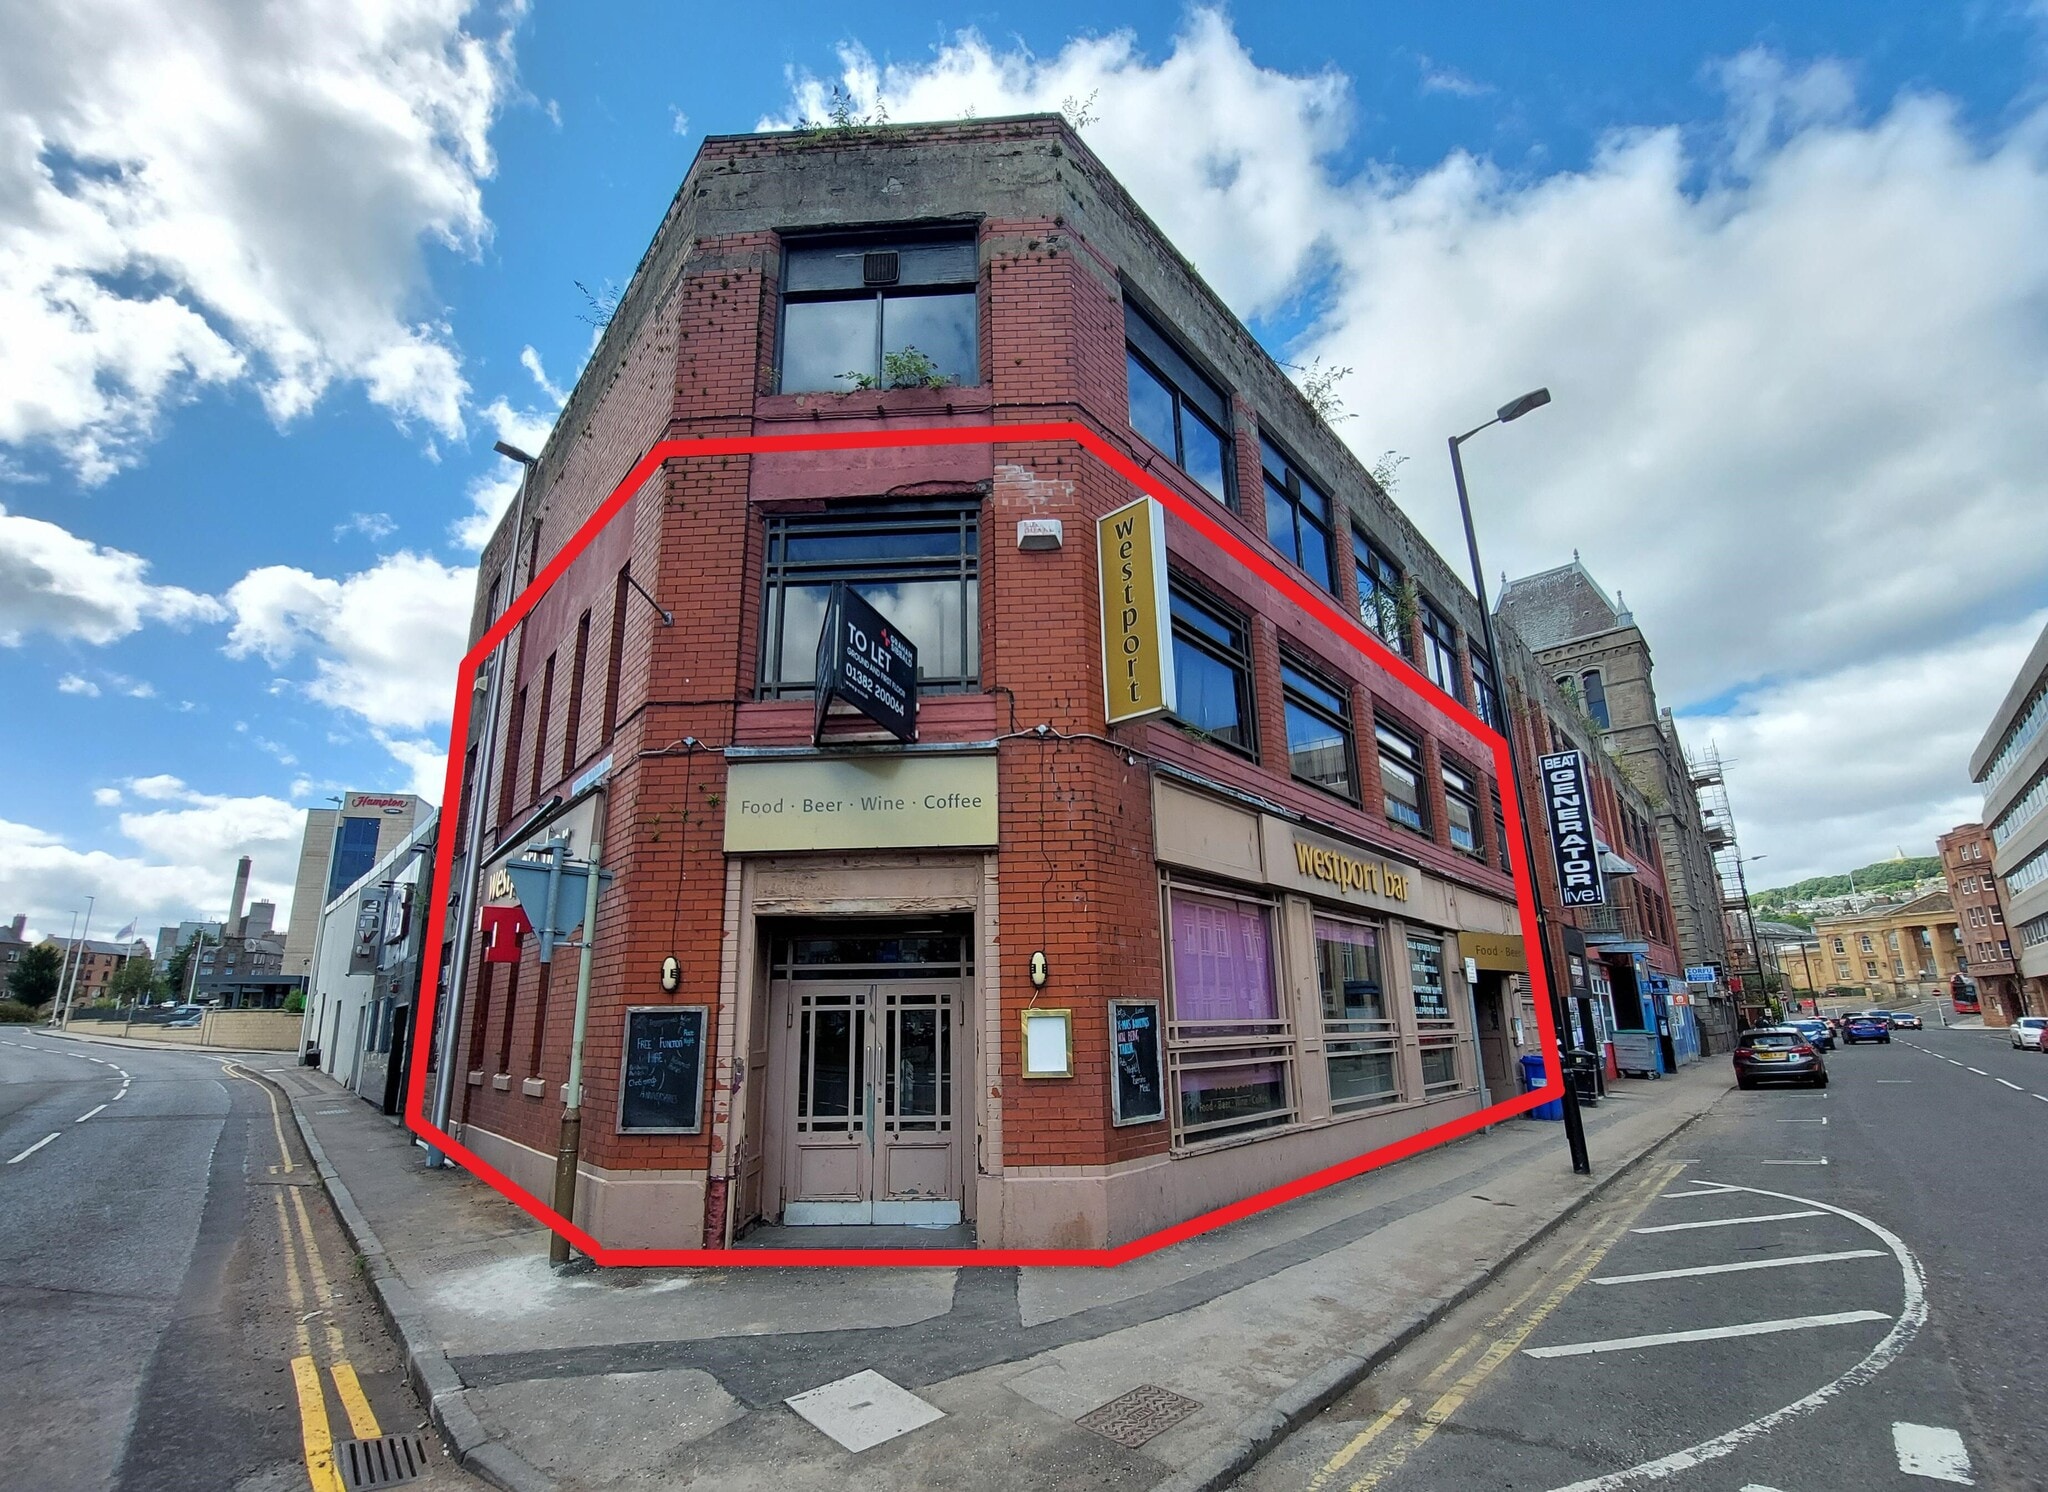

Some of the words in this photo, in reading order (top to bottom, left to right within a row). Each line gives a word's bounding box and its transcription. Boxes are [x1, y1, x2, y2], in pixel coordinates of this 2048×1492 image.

[1115, 516, 1142, 704] westport
[847, 621, 867, 652] TO
[871, 641, 892, 673] LET
[890, 634, 913, 660] GRAHAM
[846, 646, 870, 670] GROUND
[869, 661, 881, 678] AND
[881, 673, 892, 688] FIRST
[892, 680, 906, 699] FLOOR
[846, 662, 873, 693] 01382
[874, 684, 905, 717] 200064
[1544, 754, 1576, 771] BEAT
[352, 796, 408, 808] Hampton
[741, 798, 784, 815] Food
[802, 798, 843, 813] Beer
[860, 795, 905, 811] Wine
[923, 793, 982, 810] Coffee
[1550, 769, 1592, 887] GENERATOR
[1294, 841, 1378, 894] westport
[1381, 861, 1409, 903] bar
[1563, 884, 1601, 904] live!
[1475, 945, 1498, 956] Food
[637, 1037, 652, 1050] FREE
